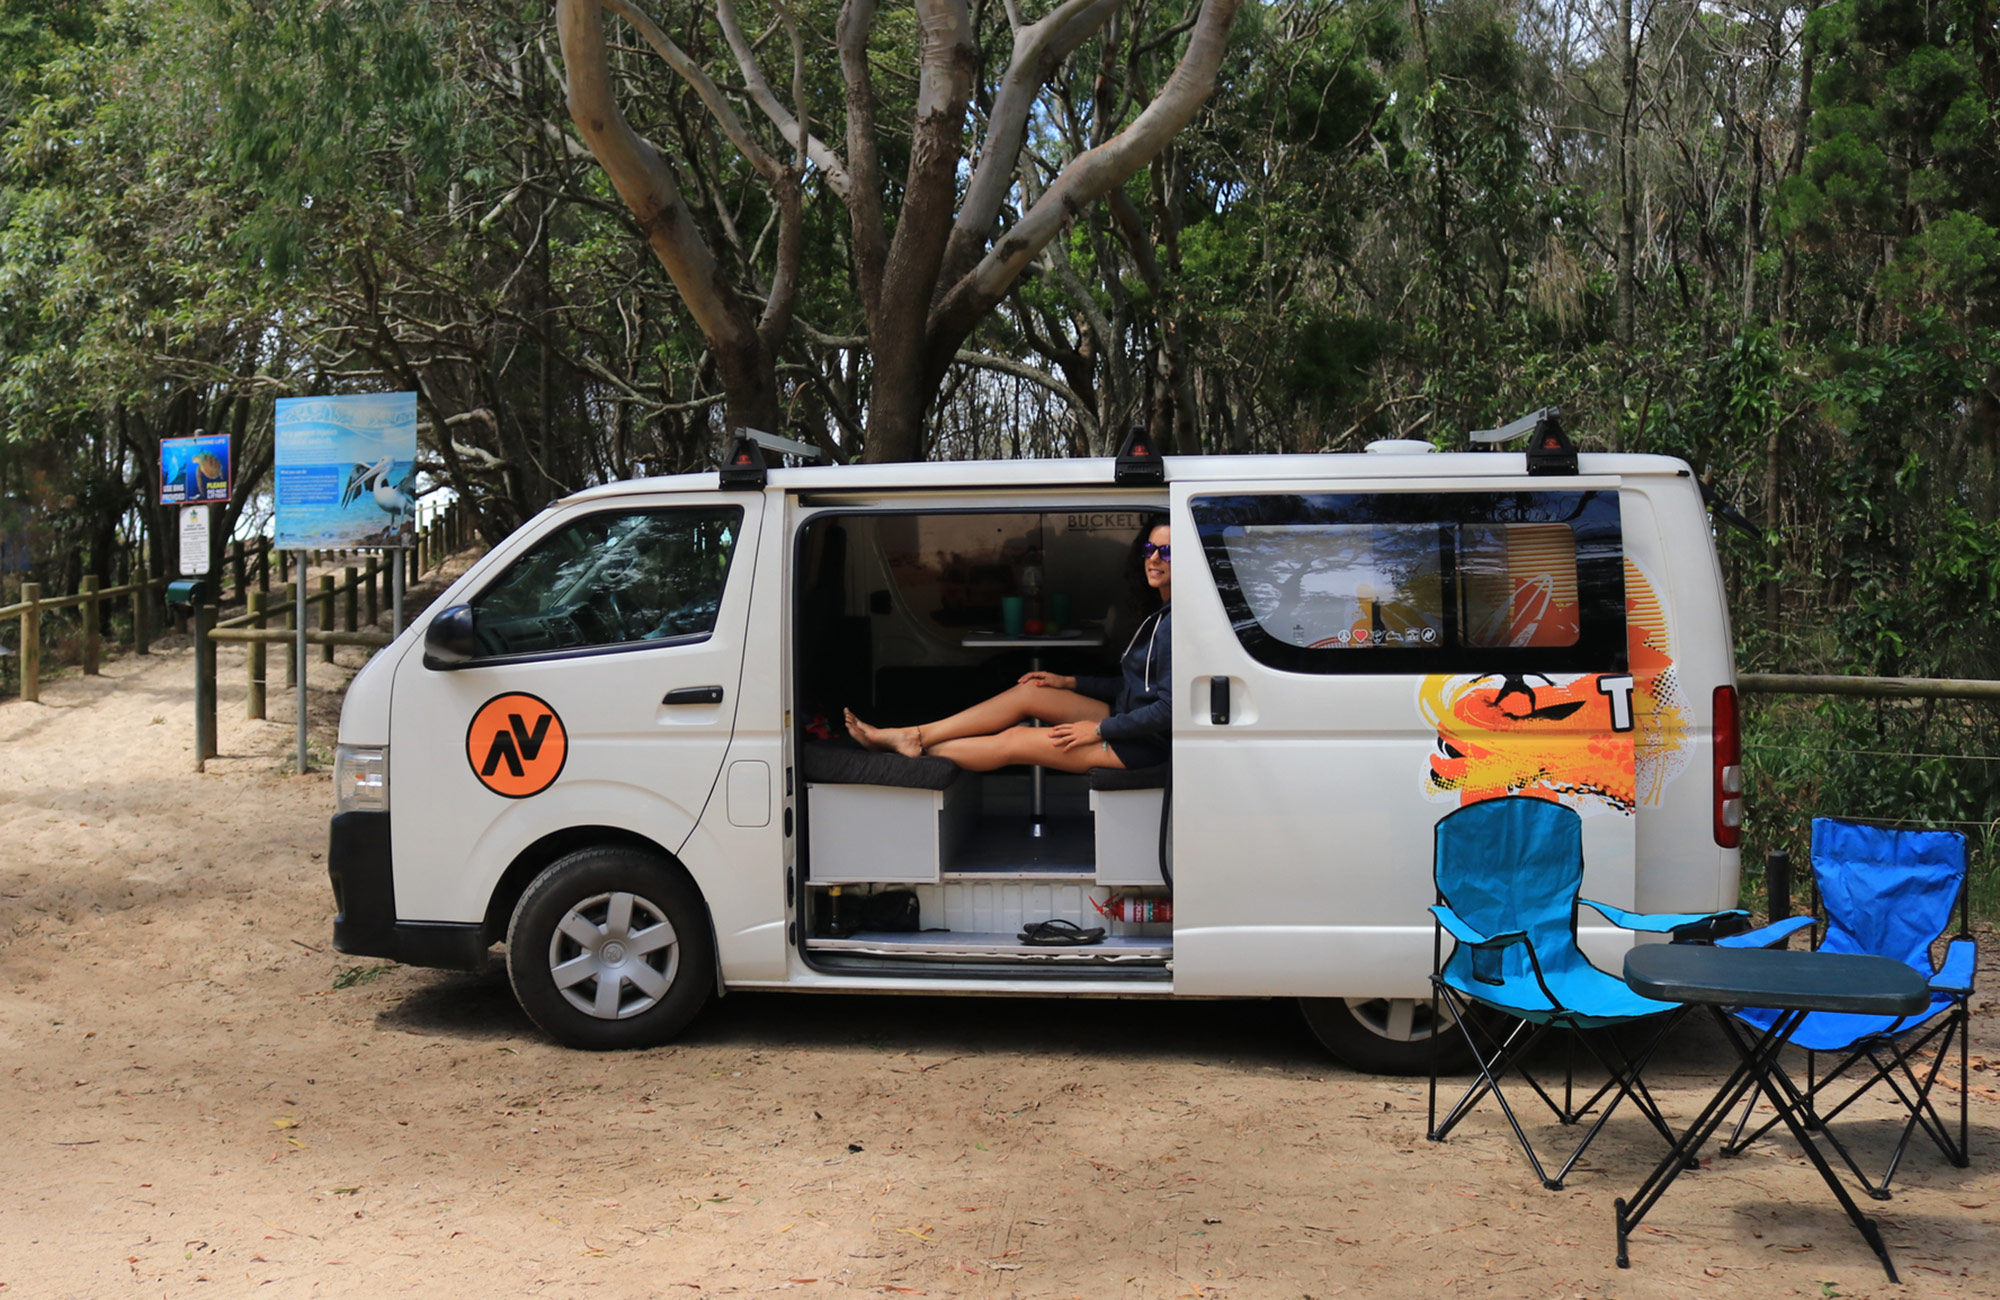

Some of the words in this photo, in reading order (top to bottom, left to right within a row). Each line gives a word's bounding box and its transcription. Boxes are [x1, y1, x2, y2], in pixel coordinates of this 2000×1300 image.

[207, 481, 227, 489] PLEASE
[1068, 514, 1134, 528] BUCKET
[1599, 675, 1634, 730] T
